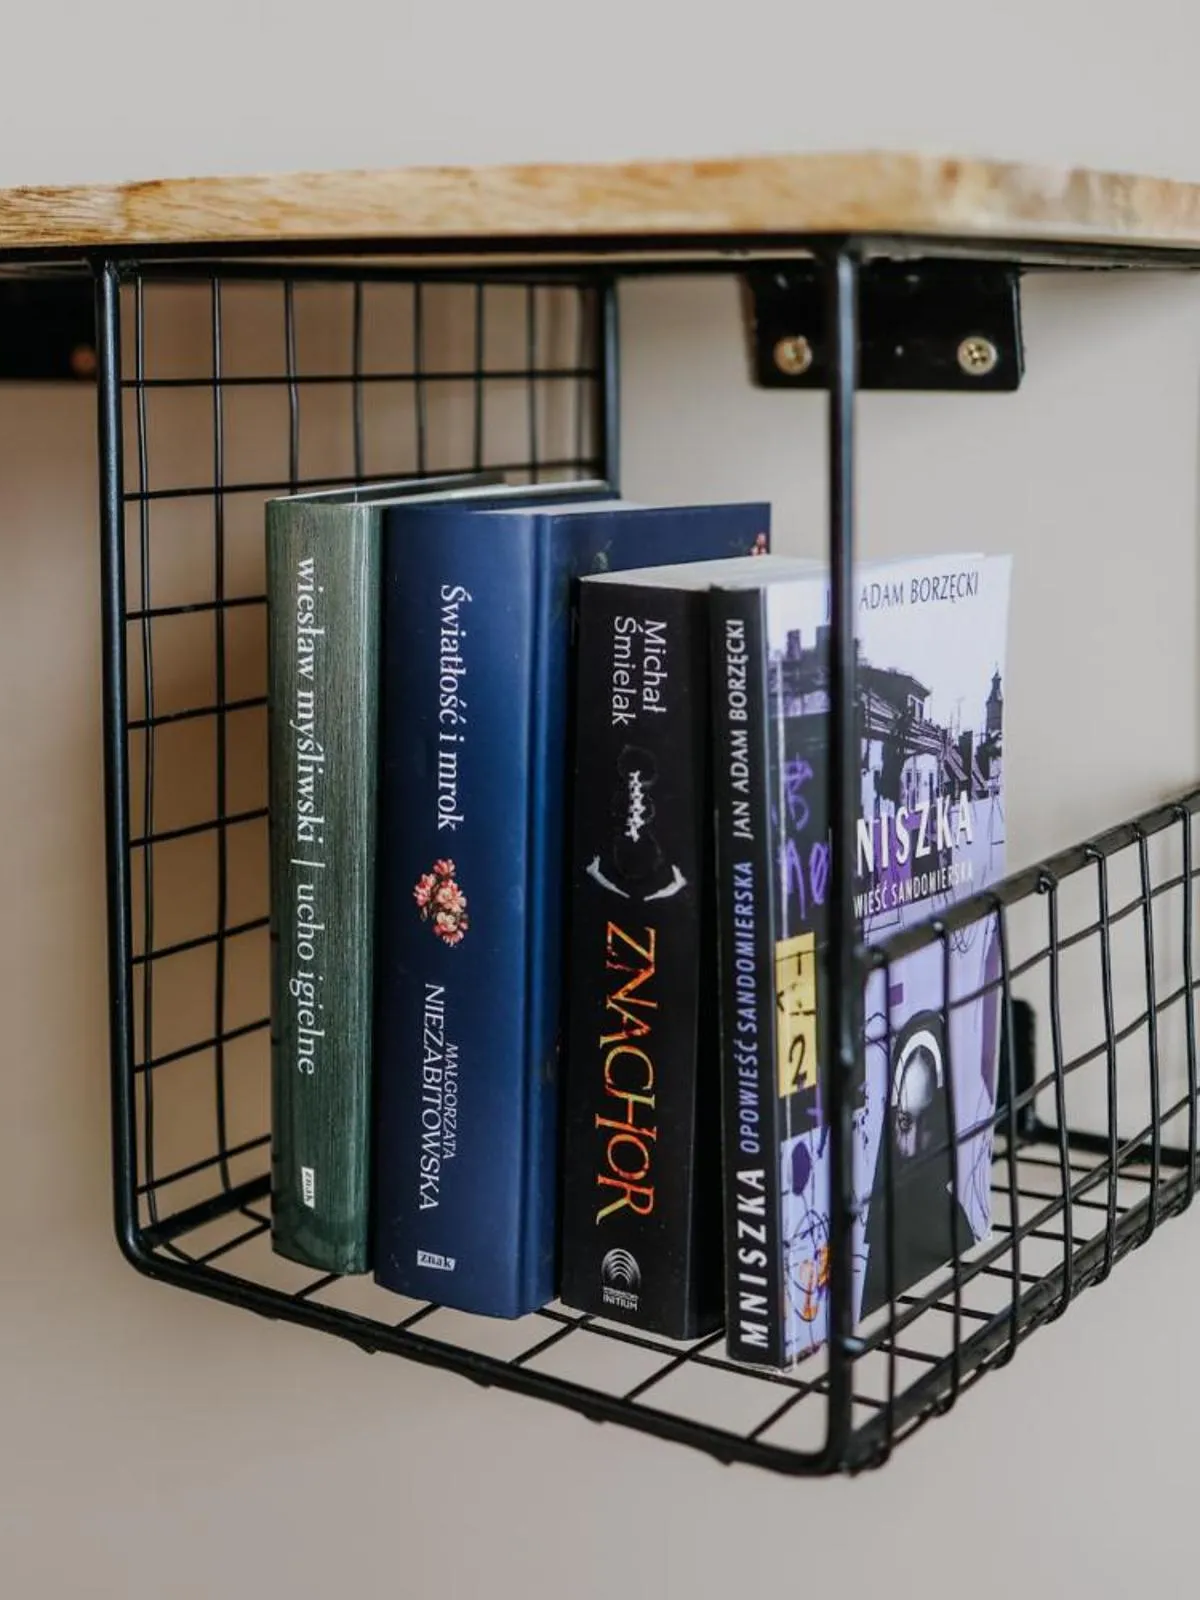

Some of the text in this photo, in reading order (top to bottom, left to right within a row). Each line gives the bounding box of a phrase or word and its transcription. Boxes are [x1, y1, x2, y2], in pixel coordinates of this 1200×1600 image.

[860, 581, 905, 610] ADAM
[911, 570, 980, 604] BORZĘCKI
[437, 584, 472, 831] Światłość i mrok
[611, 615, 644, 726] Śmielak
[642, 619, 668, 714] Michał
[725, 618, 754, 840] JAN ADAM BORZĘCKI
[289, 557, 326, 1075] wiesław myśliwski ucho igielne
[855, 790, 974, 877] NISZKA
[853, 880, 888, 919] WIEŚĆ
[418, 983, 445, 1211] NIEZABITOWSKA
[442, 1042, 459, 1160] MAŁGORZATA
[595, 921, 658, 1226] ZNACHOR
[734, 861, 770, 1348] MNISZKA OPOWIEŚĆ SANDOMIERSKA
[418, 1252, 454, 1270] znak
